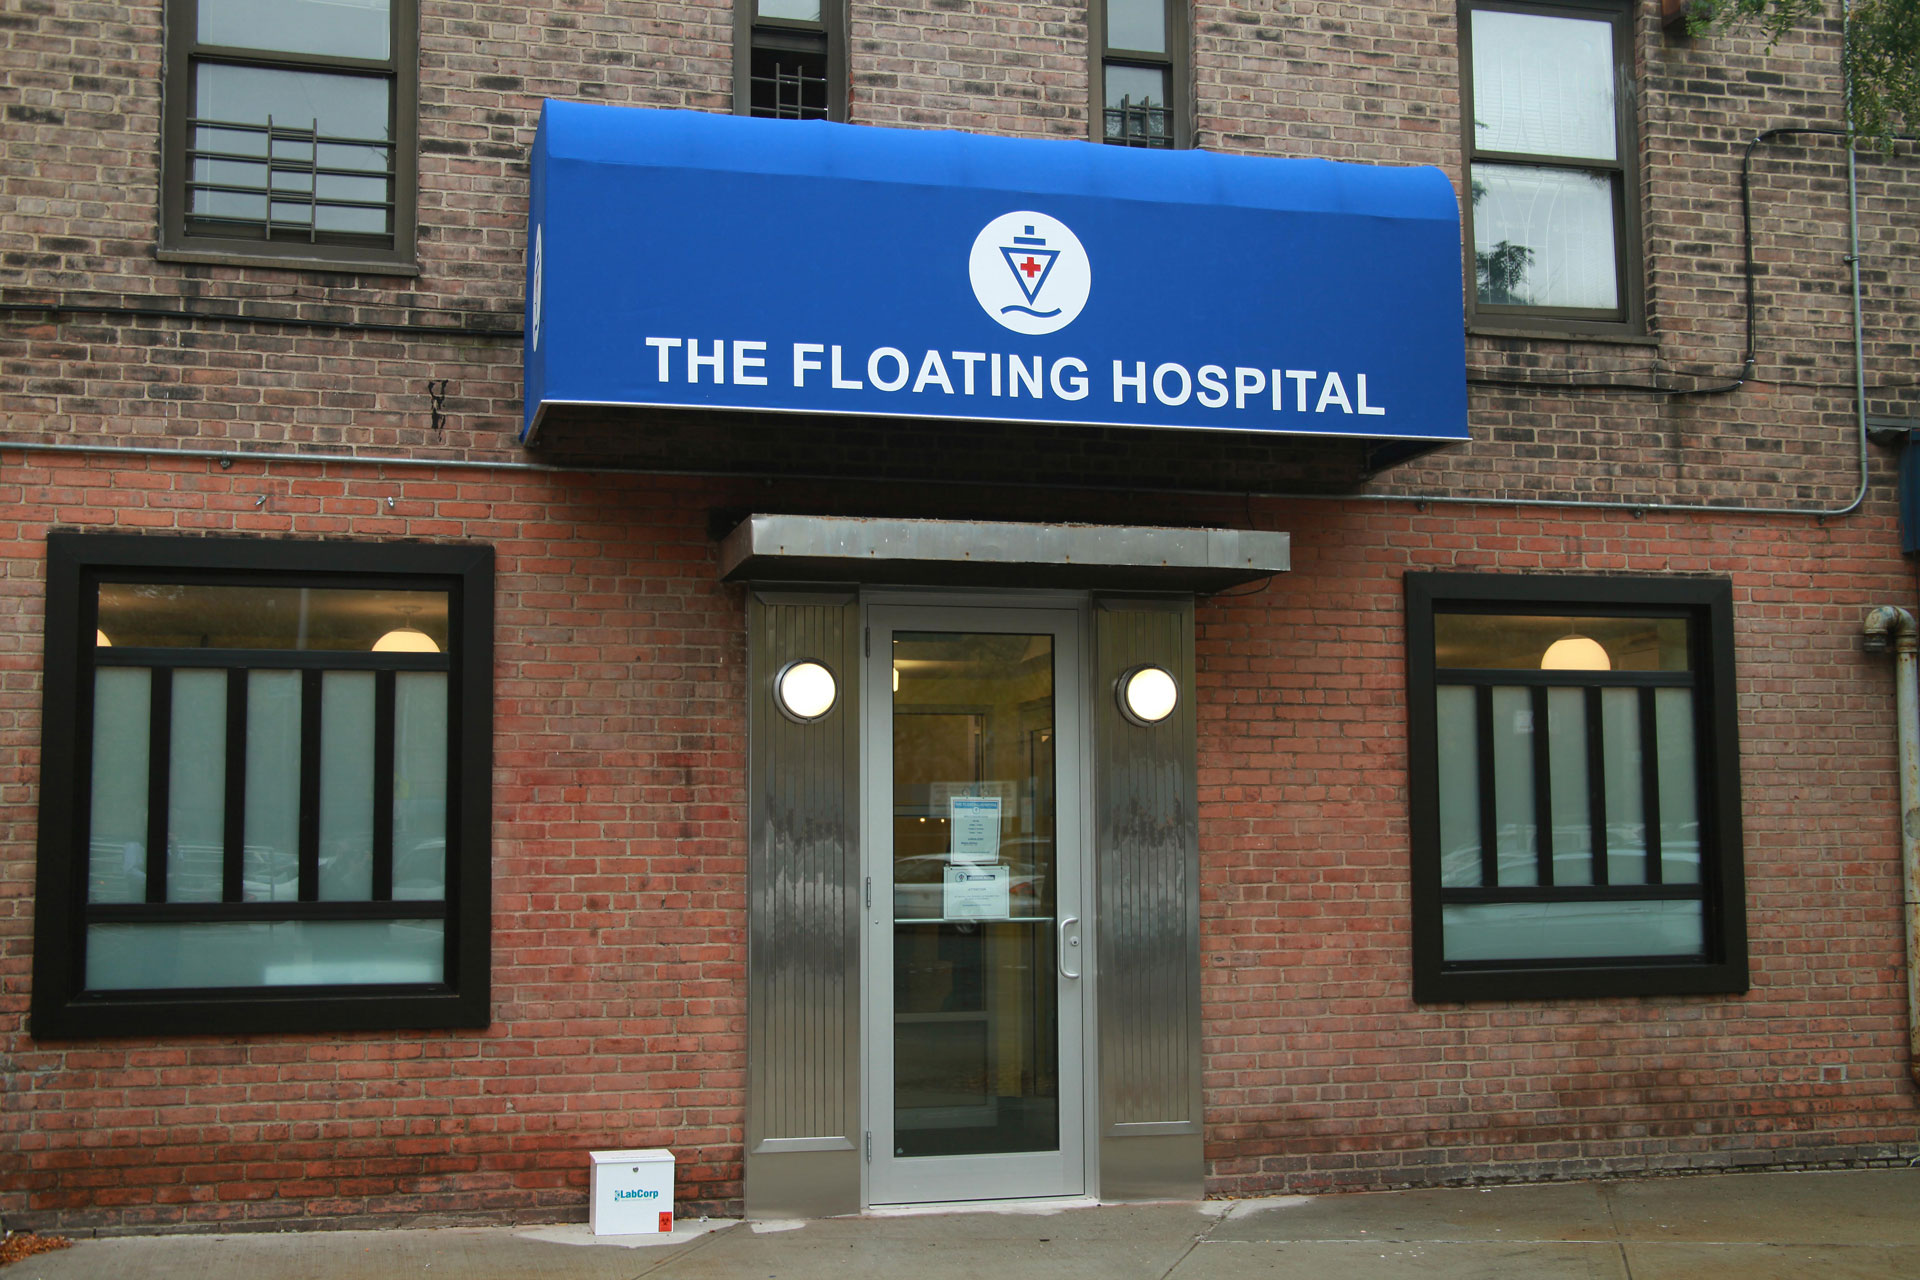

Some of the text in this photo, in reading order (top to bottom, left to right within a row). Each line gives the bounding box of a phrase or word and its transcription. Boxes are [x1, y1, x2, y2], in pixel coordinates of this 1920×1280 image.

[645, 336, 1387, 416] THE FLOATING HOSPITAL
[620, 1188, 659, 1199] LabCorp
